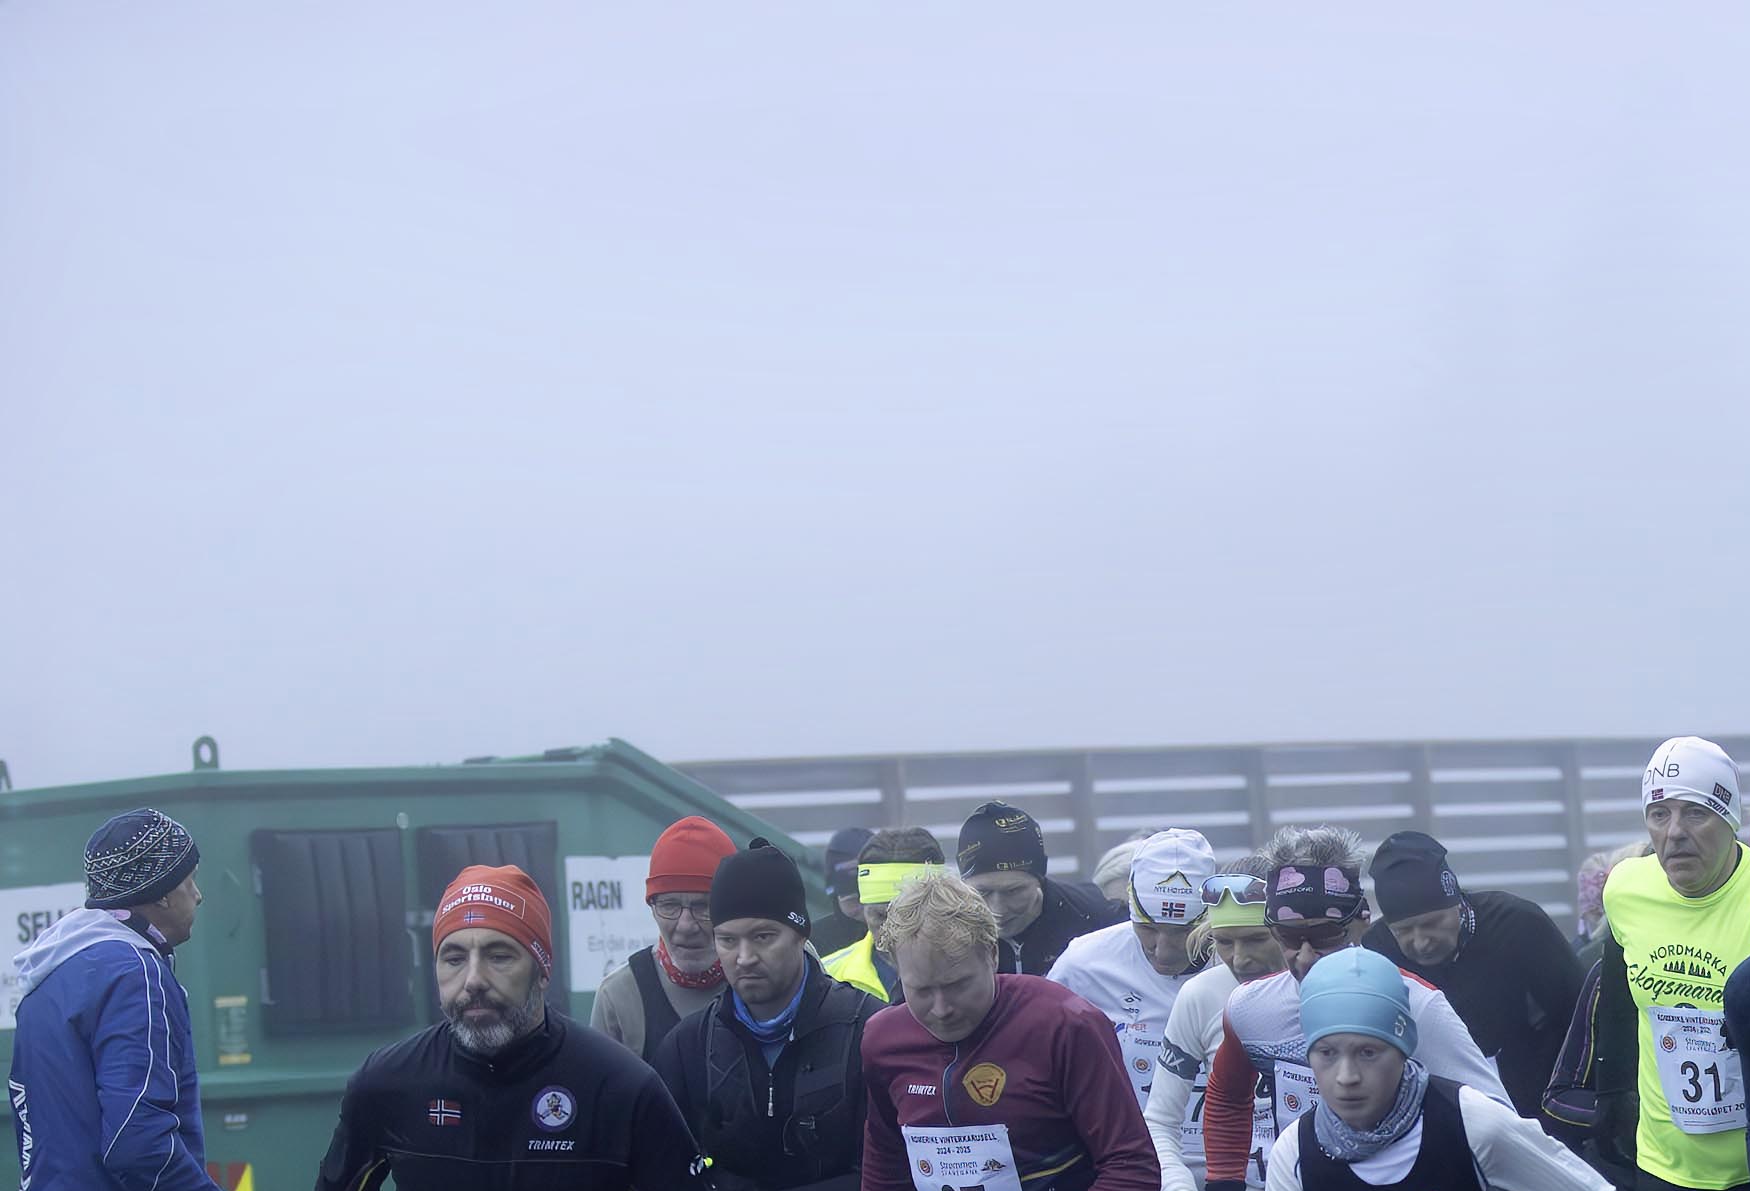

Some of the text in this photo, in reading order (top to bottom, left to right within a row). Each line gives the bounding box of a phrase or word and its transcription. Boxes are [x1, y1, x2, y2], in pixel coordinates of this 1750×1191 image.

[462, 885, 492, 895] Oslo
[571, 880, 623, 909] RAGN
[1649, 944, 1727, 977] NORDMARKA
[1629, 964, 1724, 1003] Skogsmara
[1680, 1060, 1723, 1103] 31
[528, 1140, 575, 1151] TRIMTEX
